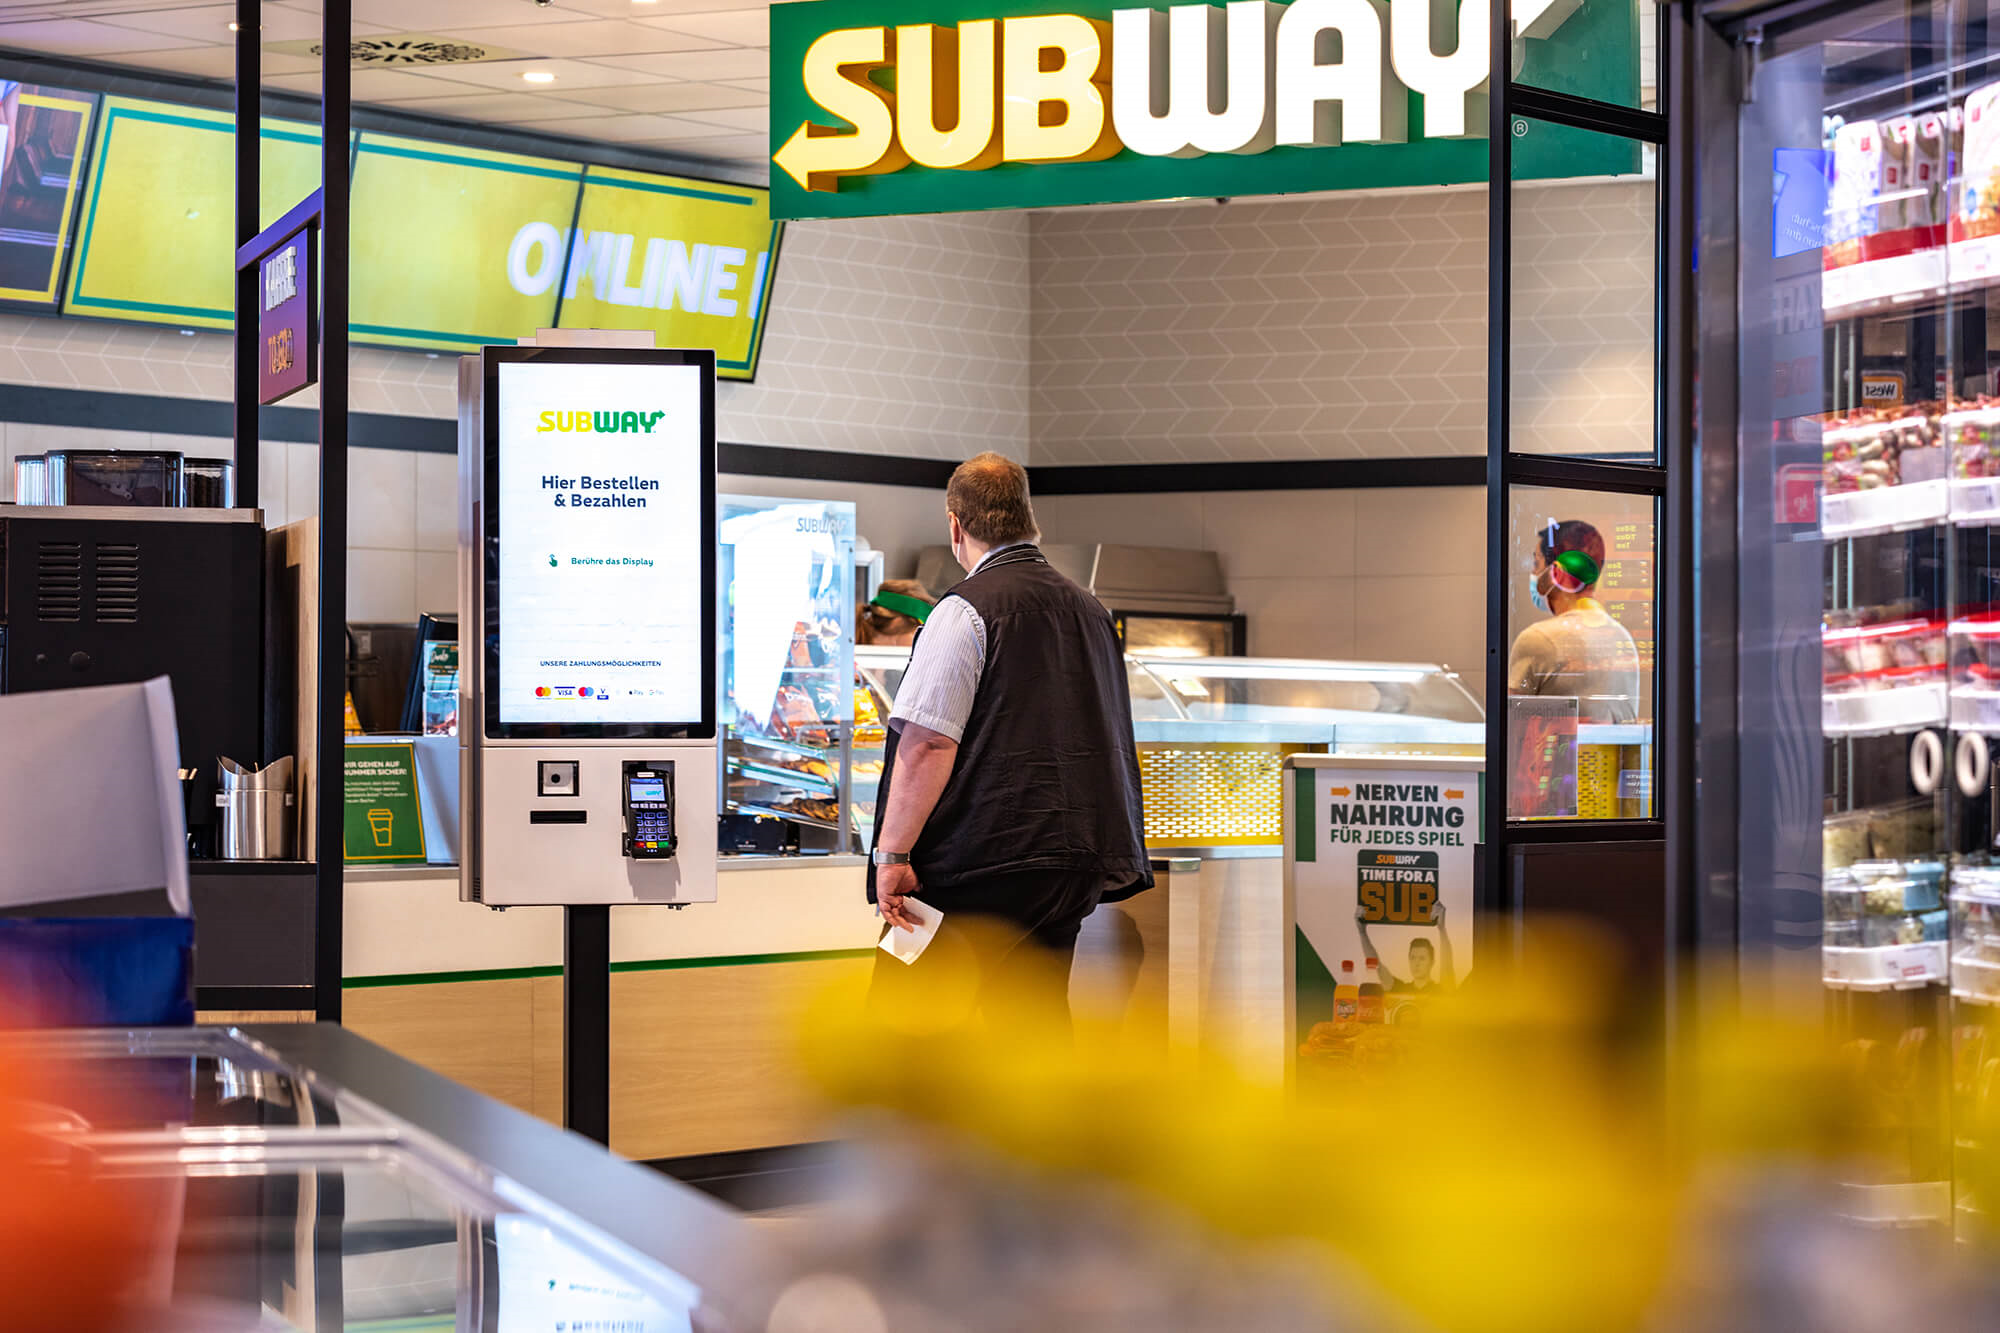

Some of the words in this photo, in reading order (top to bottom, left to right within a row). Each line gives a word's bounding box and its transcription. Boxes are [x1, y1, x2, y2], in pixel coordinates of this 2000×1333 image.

[772, 0, 1540, 190] SUBWAY
[536, 410, 666, 434] SUBWAY
[541, 475, 576, 490] Hier
[580, 475, 660, 491] Bestellen
[554, 493, 567, 508] &
[571, 493, 647, 508] Bezahlen
[571, 557, 604, 566] Berühre
[605, 557, 620, 566] das
[622, 557, 654, 567] Display
[539, 660, 568, 668] UNSERE
[569, 659, 662, 668] ZAHLUNGSMÖGLICHKEITEN
[557, 689, 573, 697] VISA
[1355, 783, 1438, 802] NERVEN
[1330, 803, 1465, 828] NAHRUNG
[1330, 826, 1362, 844] FÜR
[1365, 830, 1415, 846] JEDES
[1418, 831, 1465, 847] SPIEL
[1375, 854, 1421, 865] SUBWAY
[1360, 868, 1396, 881] TIME
[1396, 869, 1423, 883] FOR
[1424, 870, 1436, 883] A
[1360, 881, 1437, 923] SUB
